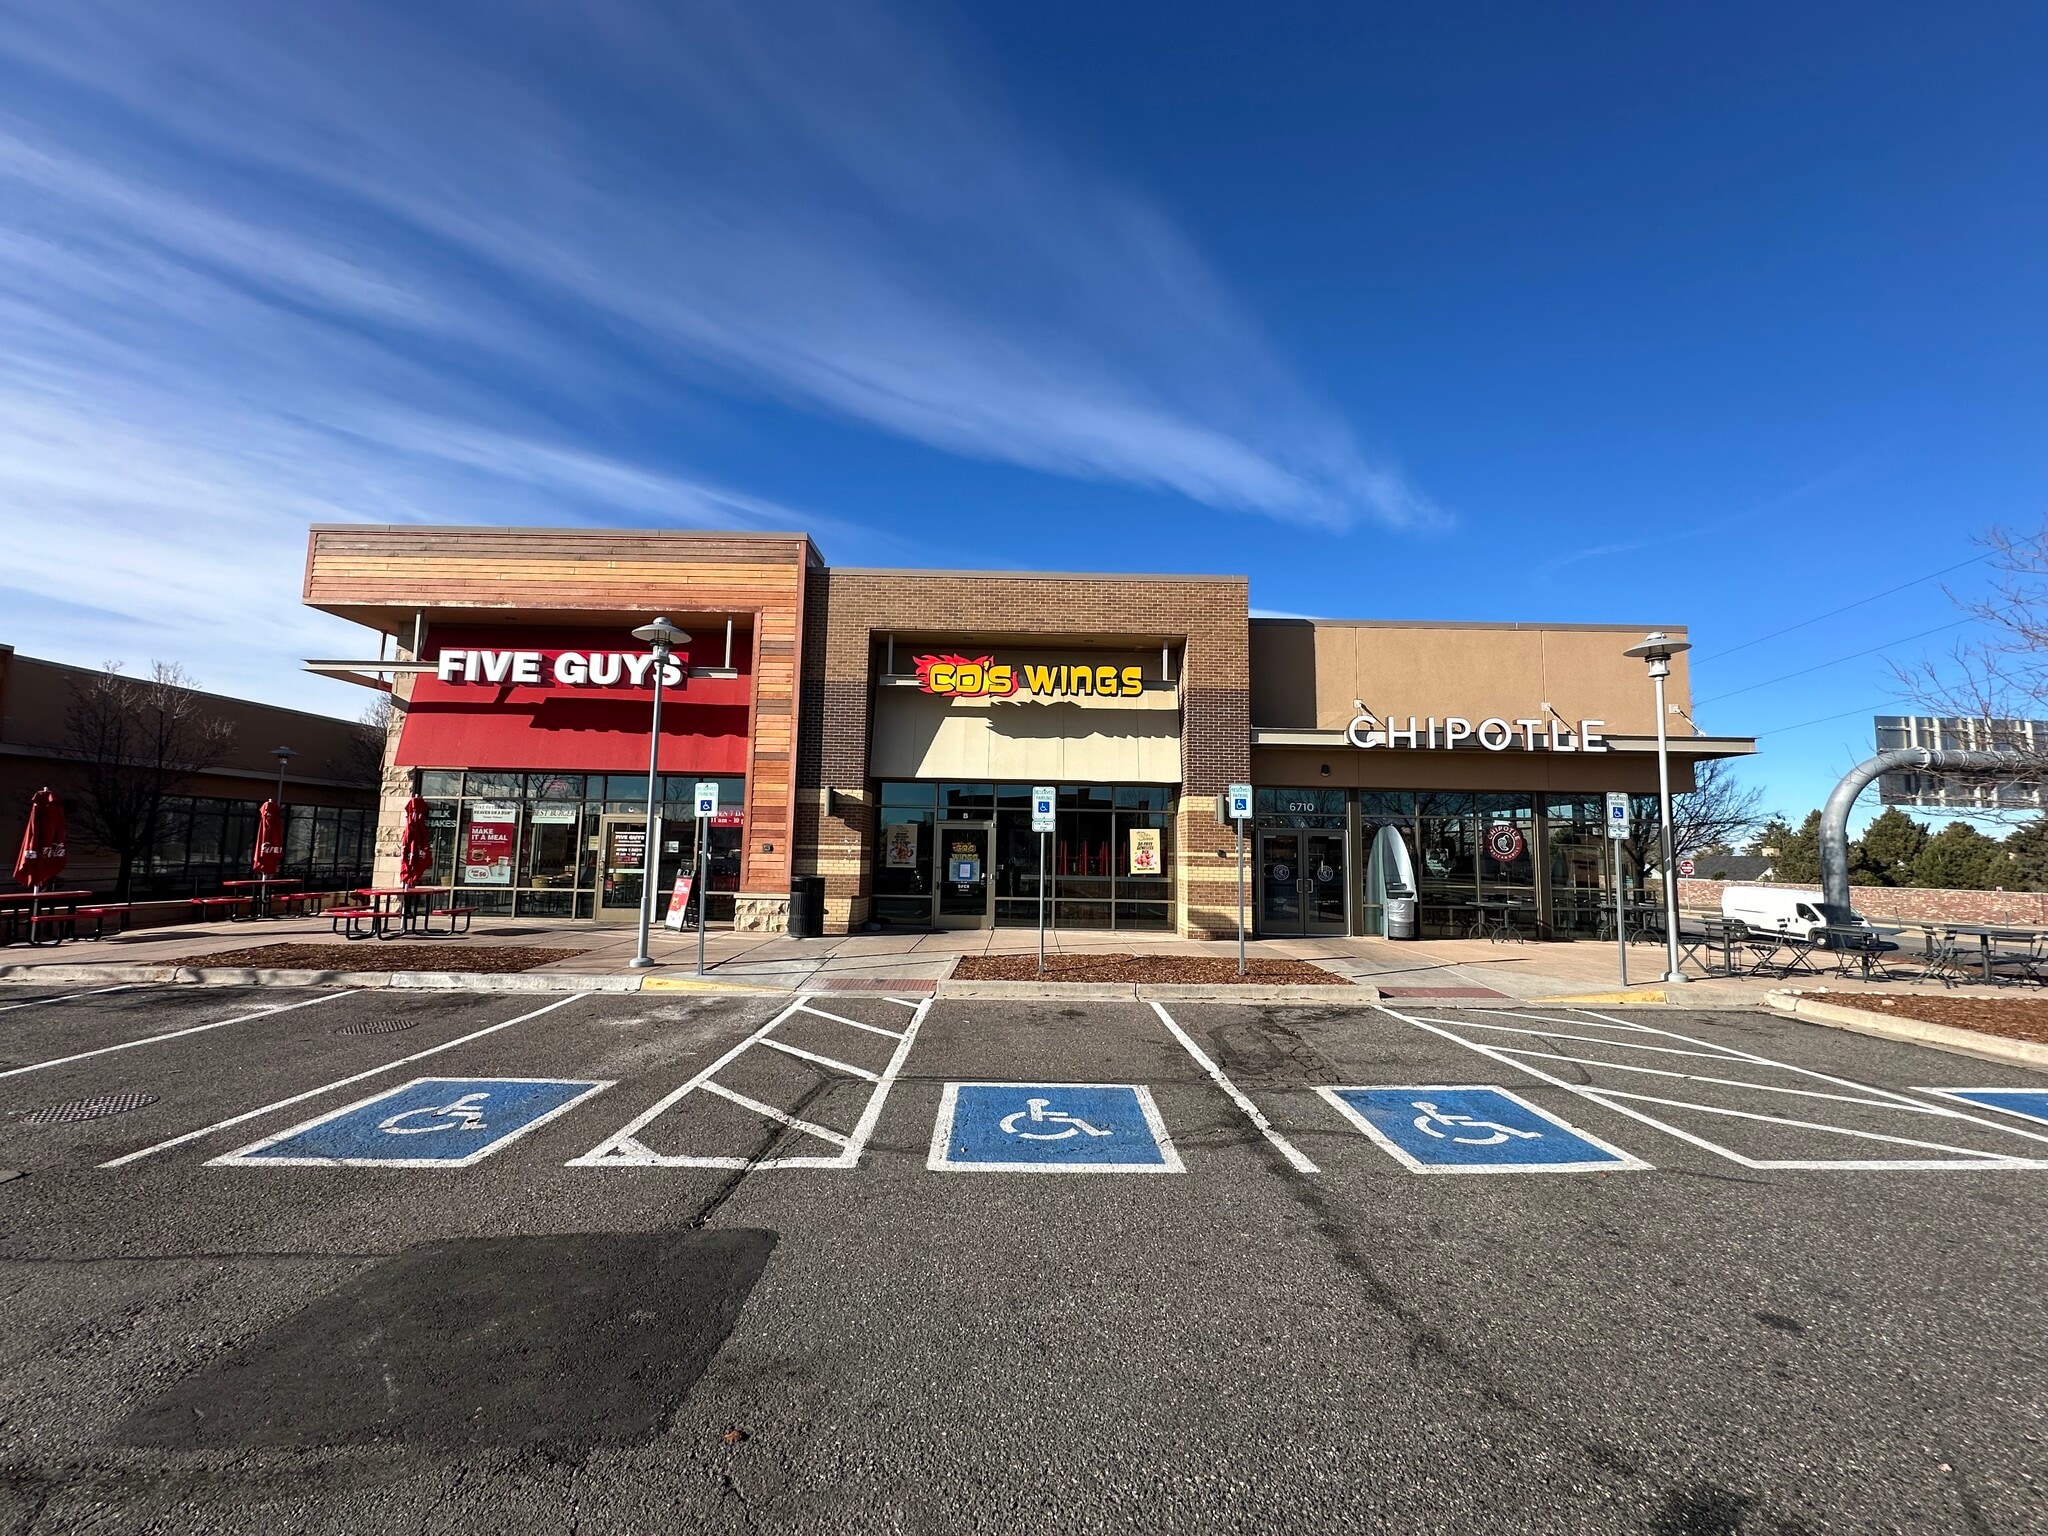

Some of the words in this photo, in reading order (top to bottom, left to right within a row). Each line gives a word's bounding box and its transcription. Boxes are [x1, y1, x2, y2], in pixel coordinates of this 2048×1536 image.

[437, 649, 542, 683] FIVE
[554, 651, 683, 686] GUYS
[1346, 715, 1608, 752] CHIPOTLE
[428, 810, 451, 818] MILK
[1289, 802, 1315, 811] 6710
[1487, 825, 1521, 840] CHIPOTLE
